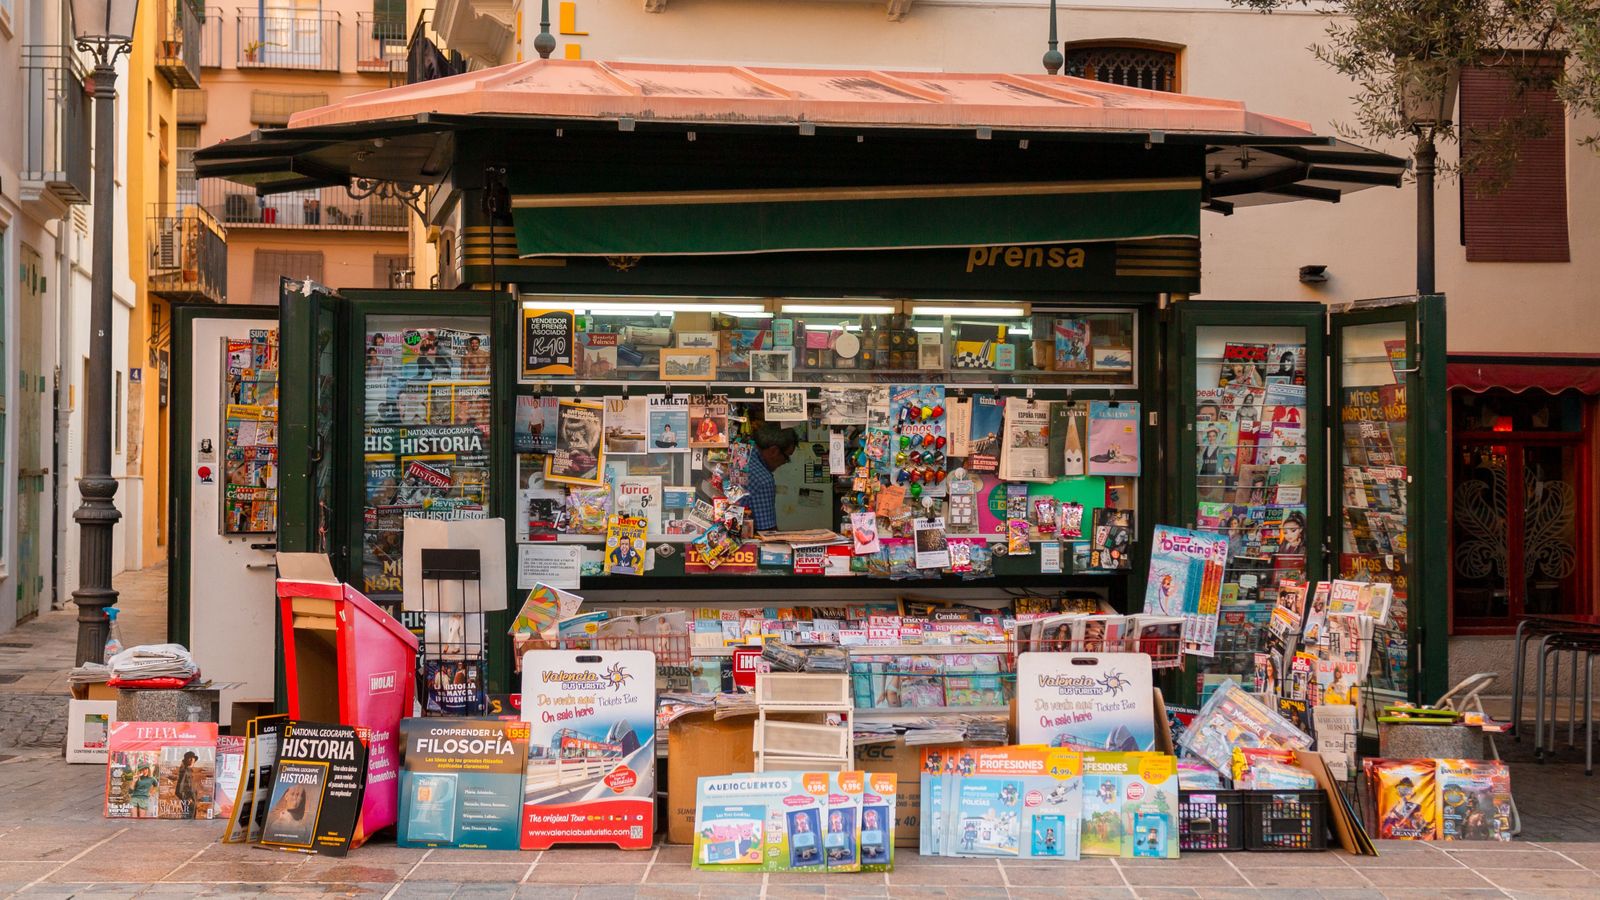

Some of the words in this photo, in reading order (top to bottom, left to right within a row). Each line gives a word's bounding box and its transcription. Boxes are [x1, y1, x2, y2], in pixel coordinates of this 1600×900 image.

[966, 246, 1085, 272] prensa
[132, 370, 138, 379] 4
[407, 428, 438, 436] NATIONAL
[439, 427, 478, 435] GEOGRAPHIC
[364, 436, 393, 451] HIS
[400, 435, 482, 453] HISTORIA
[409, 464, 450, 491] HISTORIA
[620, 483, 649, 494] Turia
[1163, 539, 1211, 558] Dancing
[542, 670, 598, 683] Valencia
[1039, 674, 1095, 687] Valencia
[562, 682, 576, 690] BUS
[577, 682, 606, 690] TURISTIC
[1058, 687, 1073, 695] BUS
[542, 711, 555, 723] On
[556, 709, 573, 720] sale
[575, 706, 594, 717] here
[1040, 716, 1053, 727] On
[1054, 715, 1071, 726] sale
[1073, 712, 1092, 723] here
[137, 727, 177, 739] TELVA
[291, 727, 319, 737] NATIONAL
[319, 729, 355, 738] GEOGRAPHIC
[430, 728, 490, 737] COMPRENDER
[492, 729, 504, 737] LA
[281, 738, 355, 760] HISTORIA
[416, 737, 515, 755] FILOSOFÍA
[980, 760, 1043, 769] PROFESIONES
[280, 773, 318, 784] HISTORIA
[708, 780, 788, 792] AUDIOCUENTOS
[808, 784, 826, 792] 9,99€
[842, 783, 861, 792] 9,99€
[875, 784, 893, 792] 9,99€
[529, 814, 541, 823] The
[542, 814, 569, 824] original
[904, 816, 916, 826] 40
[528, 828, 630, 837] www.valenciabusturistic.com
